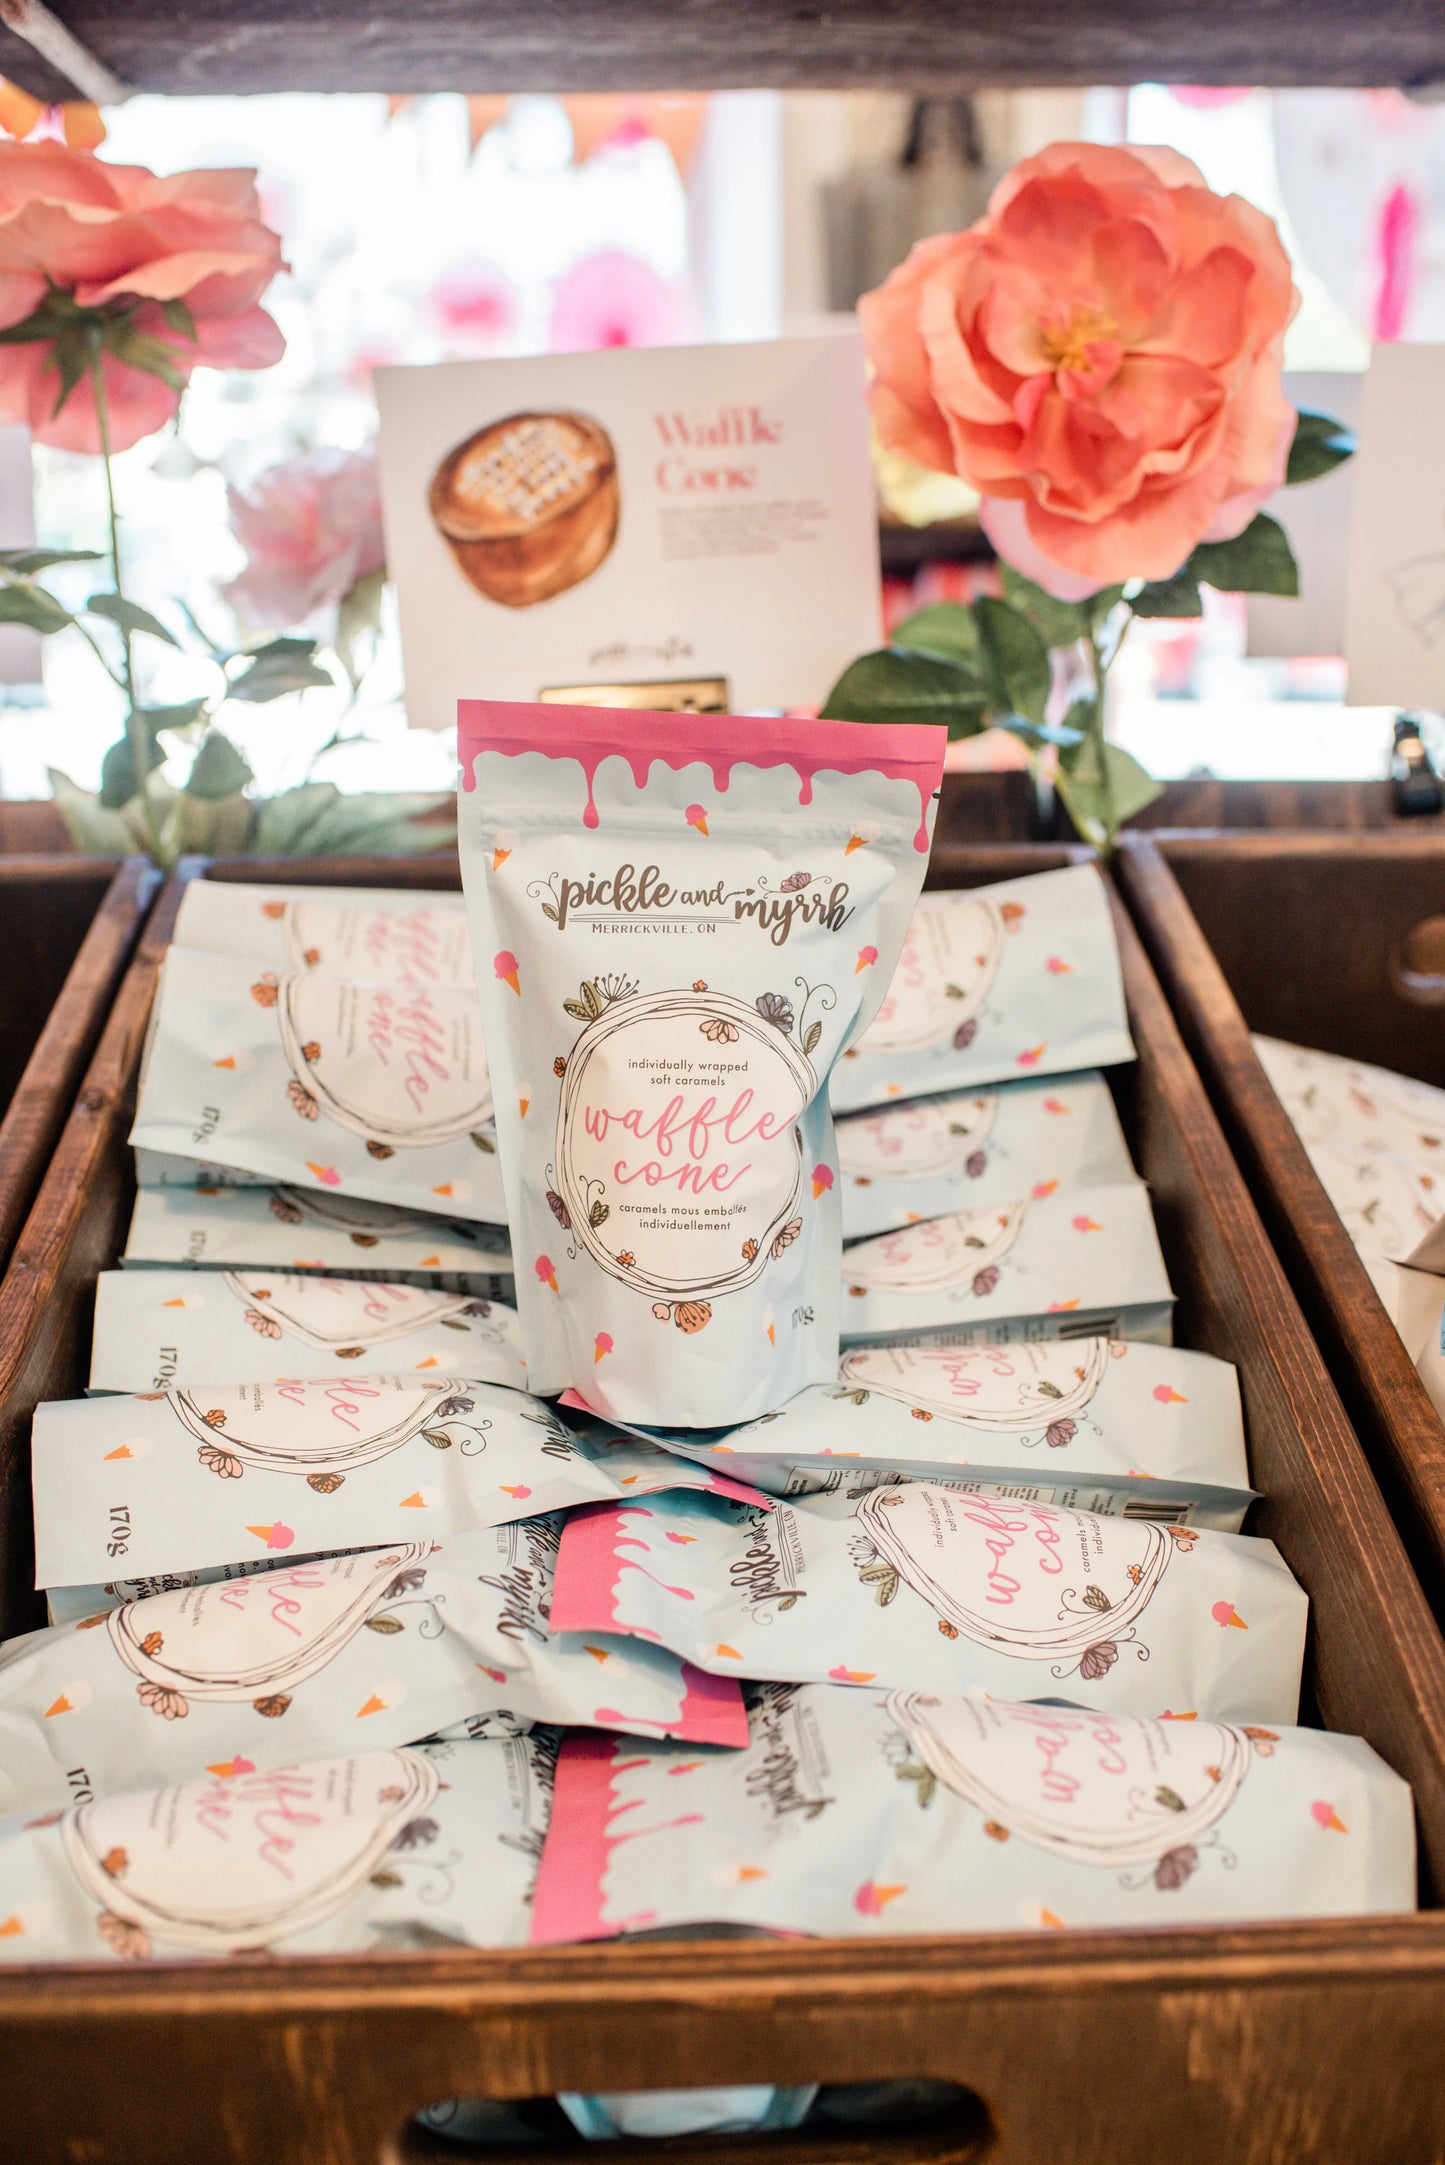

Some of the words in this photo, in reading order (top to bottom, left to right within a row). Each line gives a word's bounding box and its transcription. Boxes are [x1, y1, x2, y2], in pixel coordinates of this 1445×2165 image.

[655, 459, 757, 493] Cone
[558, 864, 677, 931] pickle
[680, 880, 730, 906] and
[734, 882, 856, 947] myrrh
[697, 923, 716, 933] ON
[367, 992, 393, 1067] one
[628, 1059, 694, 1072] individually
[698, 1060, 748, 1072] wrapped
[650, 1075, 671, 1085] soft
[675, 1076, 726, 1087] caramels
[585, 1088, 797, 1160] waffle
[613, 1160, 753, 1194] cone
[619, 1203, 667, 1215] caramels
[671, 1206, 700, 1216] mous
[639, 1219, 731, 1231] individuellement
[107, 1504, 131, 1559] 170g
[783, 1510, 794, 1522] ON
[943, 1518, 957, 1532] soft
[743, 1525, 770, 1545] and
[943, 1488, 1028, 1605] waffl
[1077, 1529, 1091, 1573] caramels
[729, 1543, 807, 1604] pickle
[478, 1566, 548, 1642] myrrh
